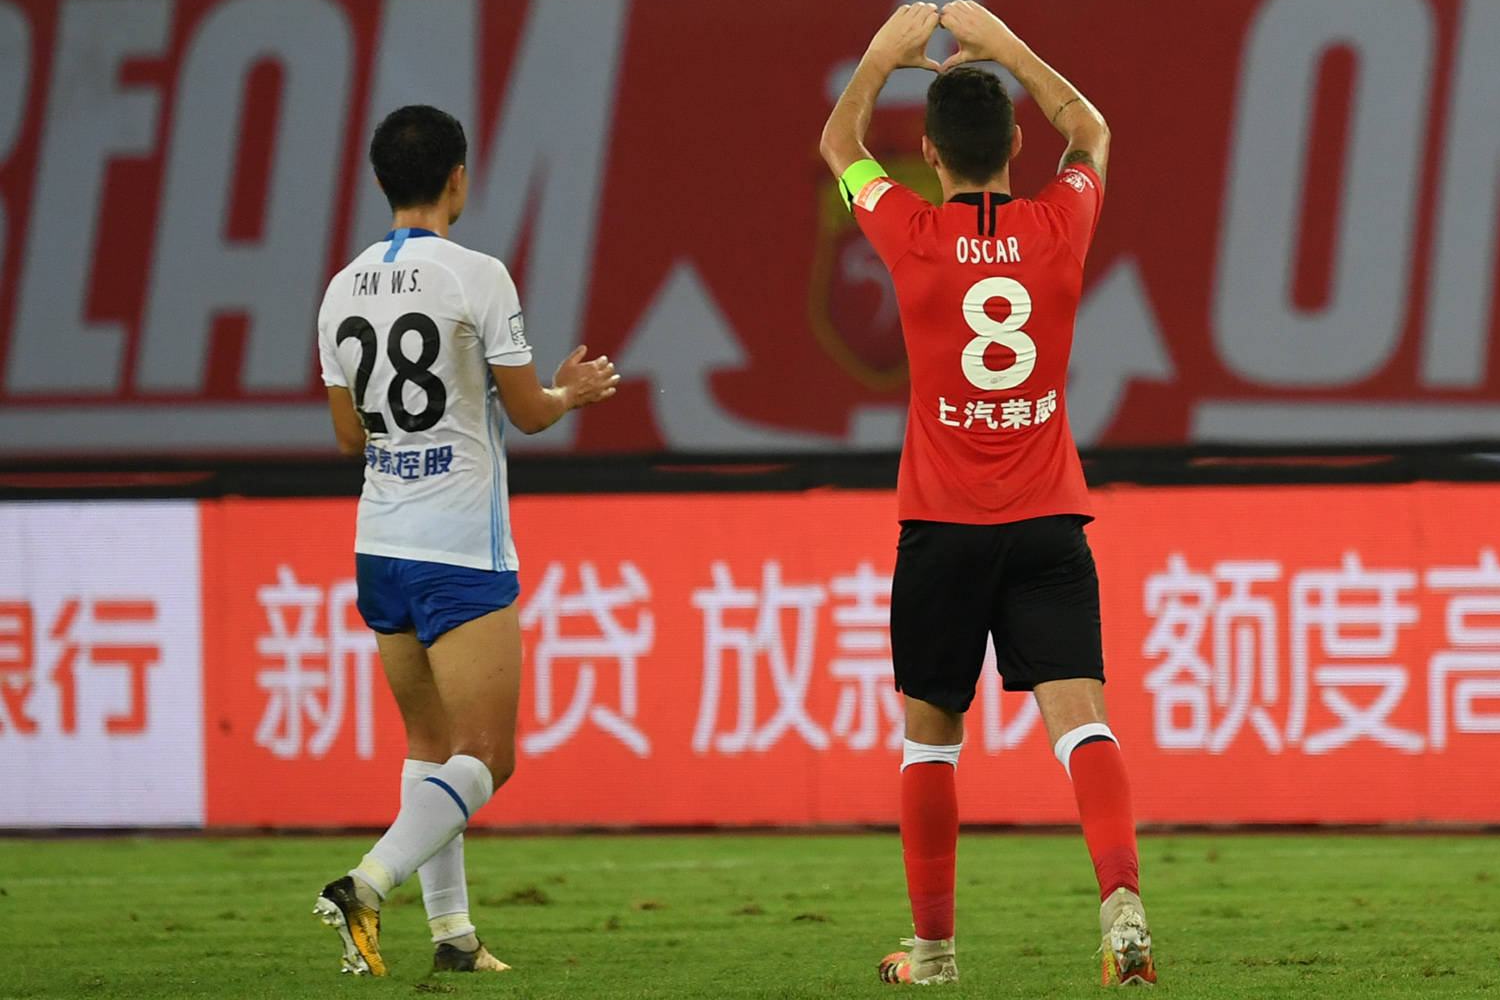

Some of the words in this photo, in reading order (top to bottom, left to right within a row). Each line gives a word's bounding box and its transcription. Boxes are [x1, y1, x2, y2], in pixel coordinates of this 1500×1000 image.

[352, 271, 381, 297] TAN
[391, 268, 422, 294] W.S.
[955, 236, 1021, 264] OSCAR
[336, 311, 447, 434] 28
[960, 276, 1038, 391] 8
[938, 389, 1058, 430] 上汽荣威
[254, 562, 656, 761] 新贷
[690, 560, 1044, 756] 放款
